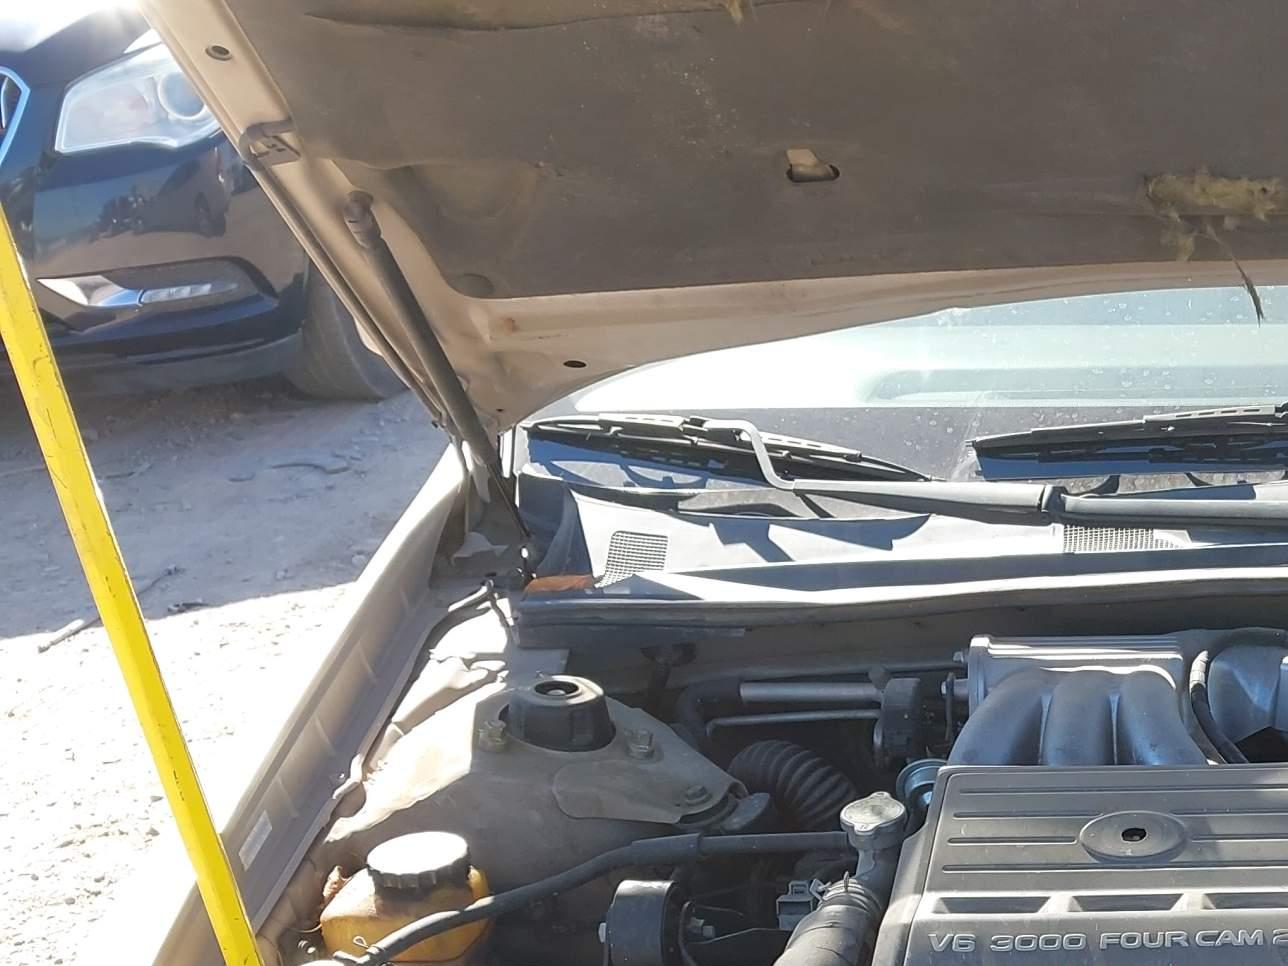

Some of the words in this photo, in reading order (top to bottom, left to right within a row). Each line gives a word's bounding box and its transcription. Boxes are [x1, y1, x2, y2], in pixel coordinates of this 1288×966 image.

[928, 931, 976, 952] V6
[990, 931, 1087, 952] 3000
[1098, 930, 1188, 950] FOUR
[1194, 928, 1264, 948] CAM
